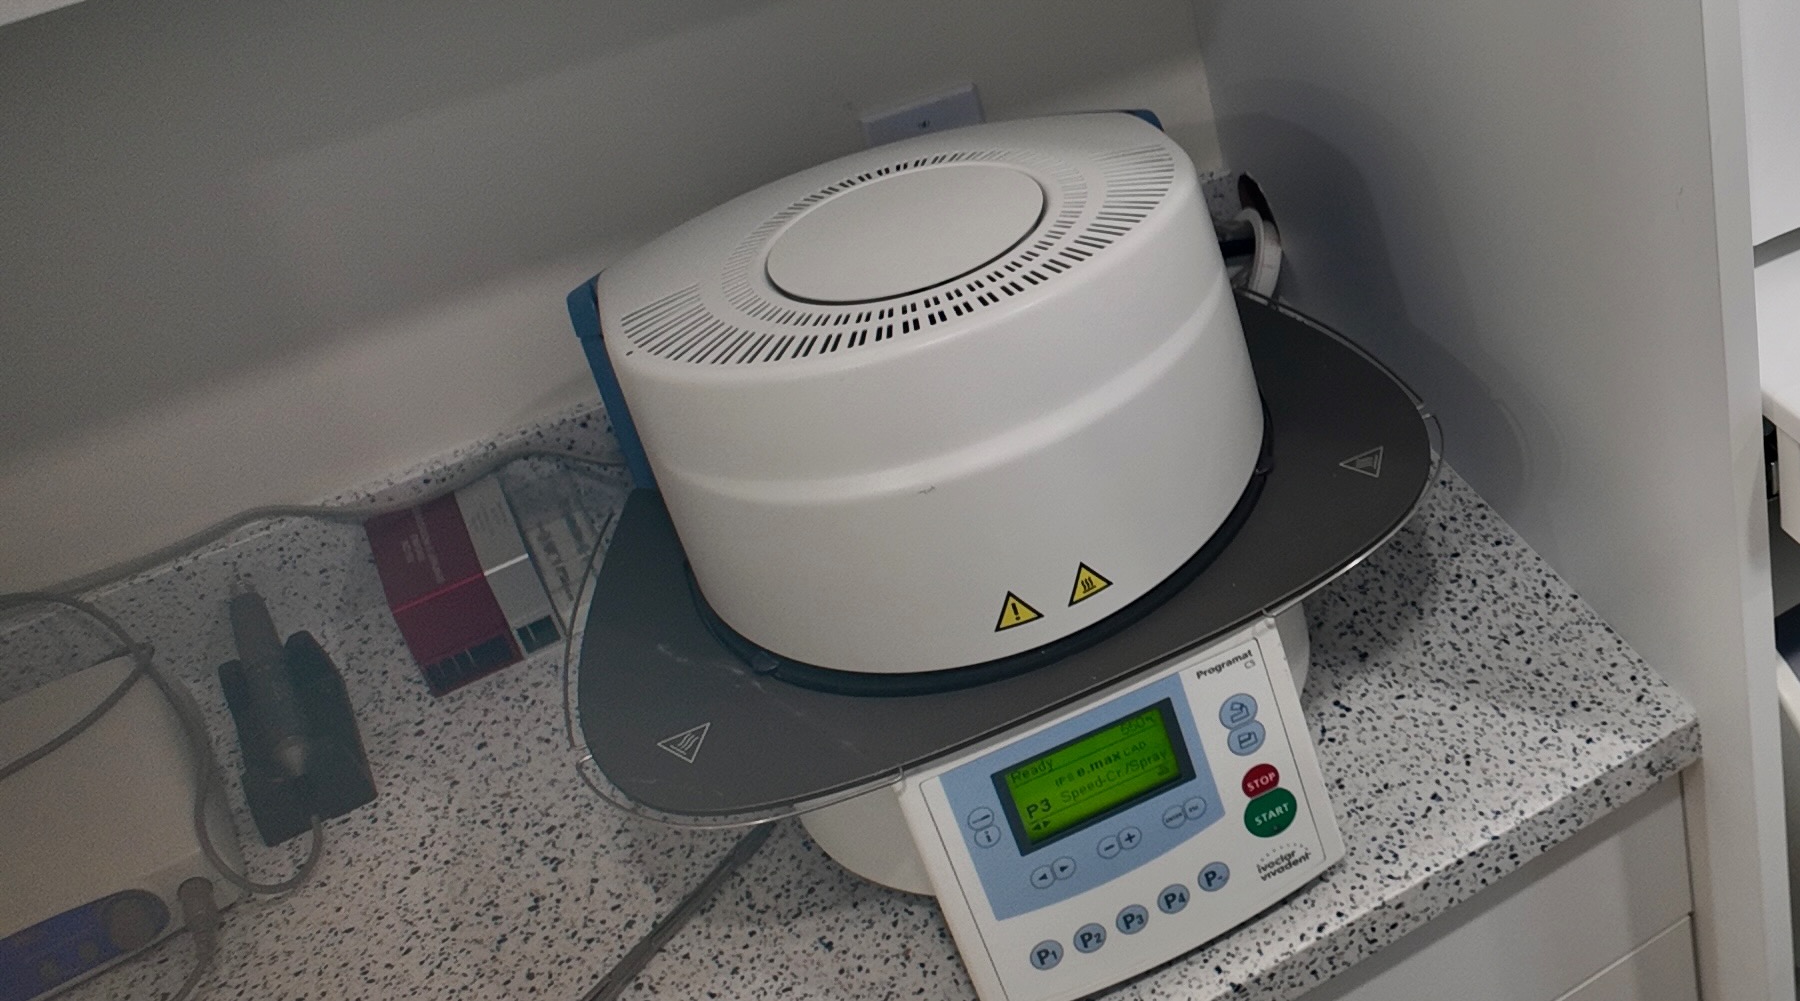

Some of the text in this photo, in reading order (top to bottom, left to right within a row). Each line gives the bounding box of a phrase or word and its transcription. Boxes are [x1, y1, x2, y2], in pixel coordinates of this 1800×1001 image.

[1196, 649, 1253, 680] Programat
[1010, 759, 1054, 785] Ready
[1077, 752, 1121, 778] e.max
[1246, 771, 1277, 793] STOP
[1026, 798, 1052, 820] P3
[1254, 802, 1290, 826] START
[1256, 850, 1296, 874] ivoclar
[1164, 892, 1186, 909] P4
[1123, 912, 1145, 930] P3
[1080, 932, 1102, 949] P2
[1036, 948, 1058, 966] P1
